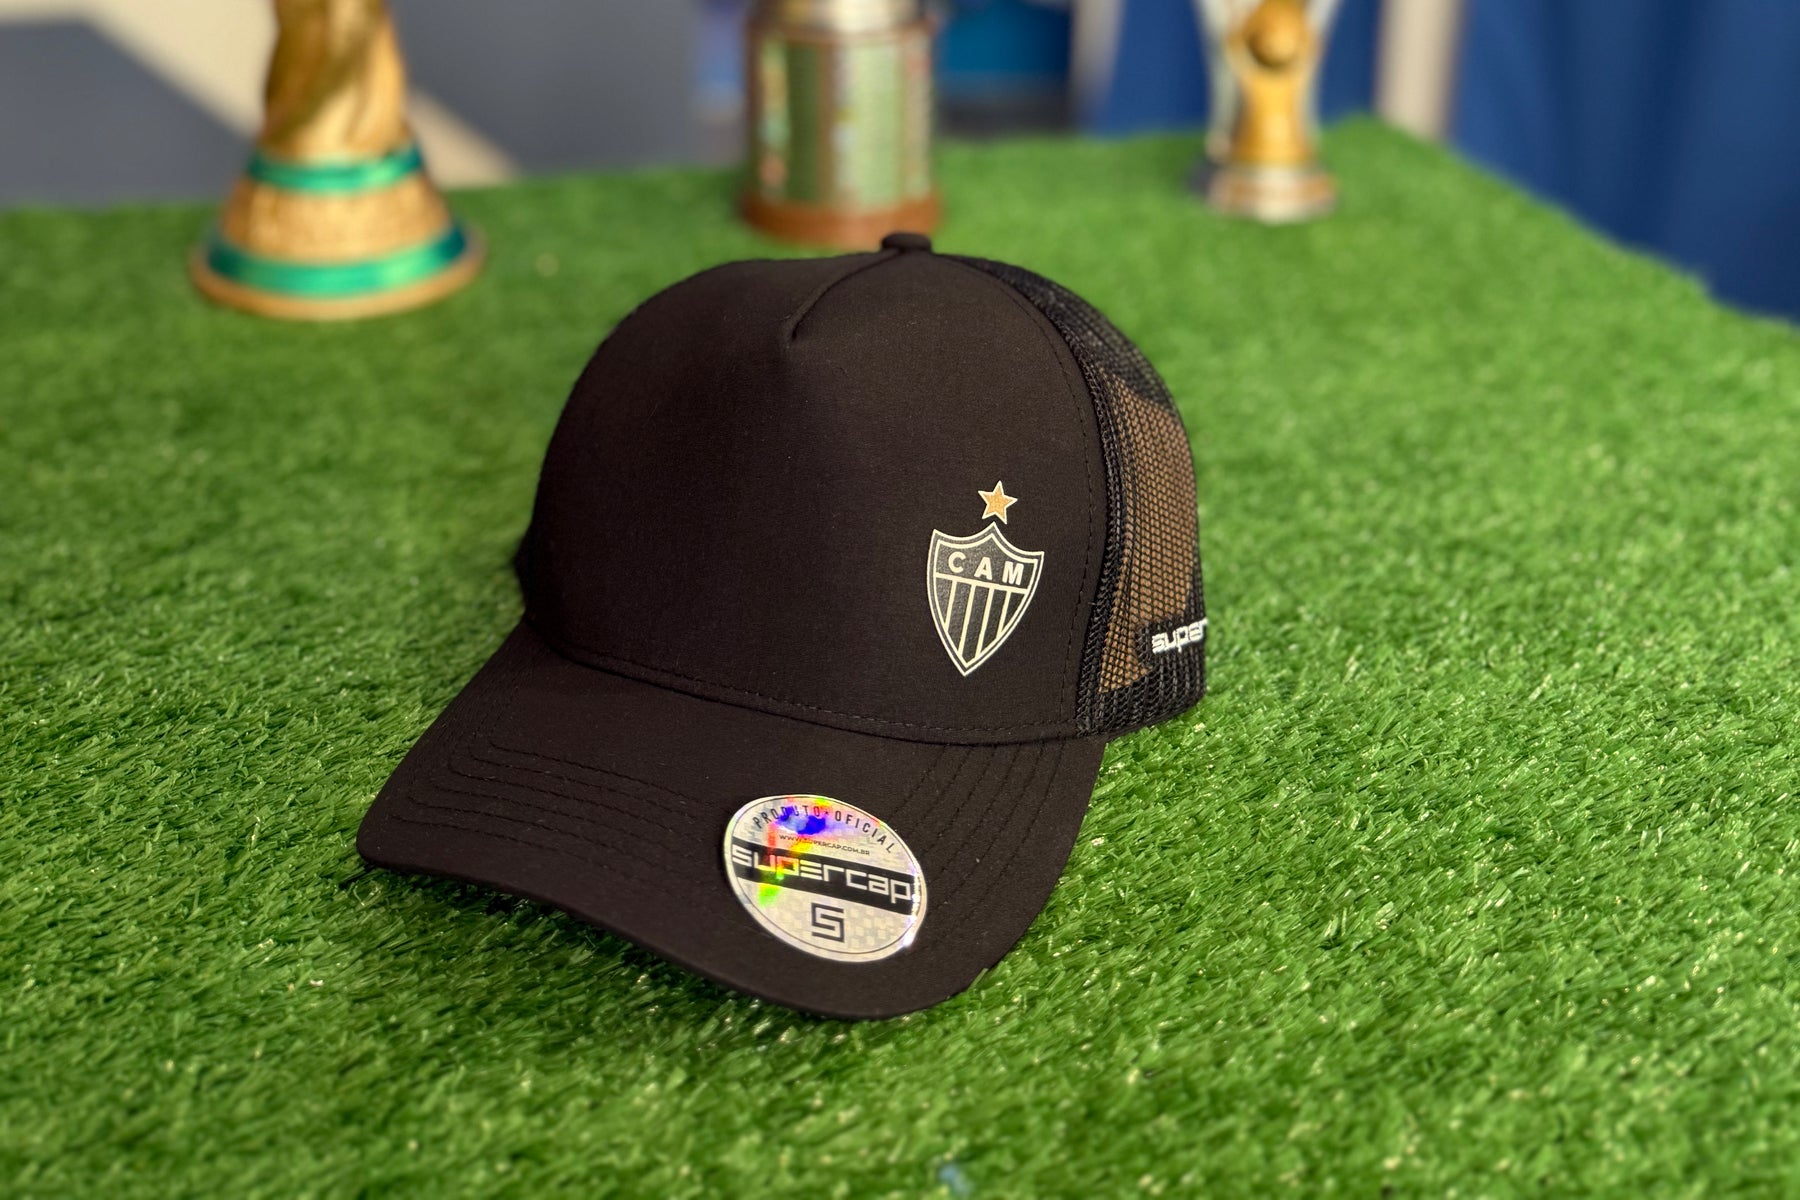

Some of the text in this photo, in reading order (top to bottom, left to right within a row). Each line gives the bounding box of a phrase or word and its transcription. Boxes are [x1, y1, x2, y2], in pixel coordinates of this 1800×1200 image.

[949, 551, 1024, 585] CAM
[752, 805, 897, 853] PRODUTO OFICIAL
